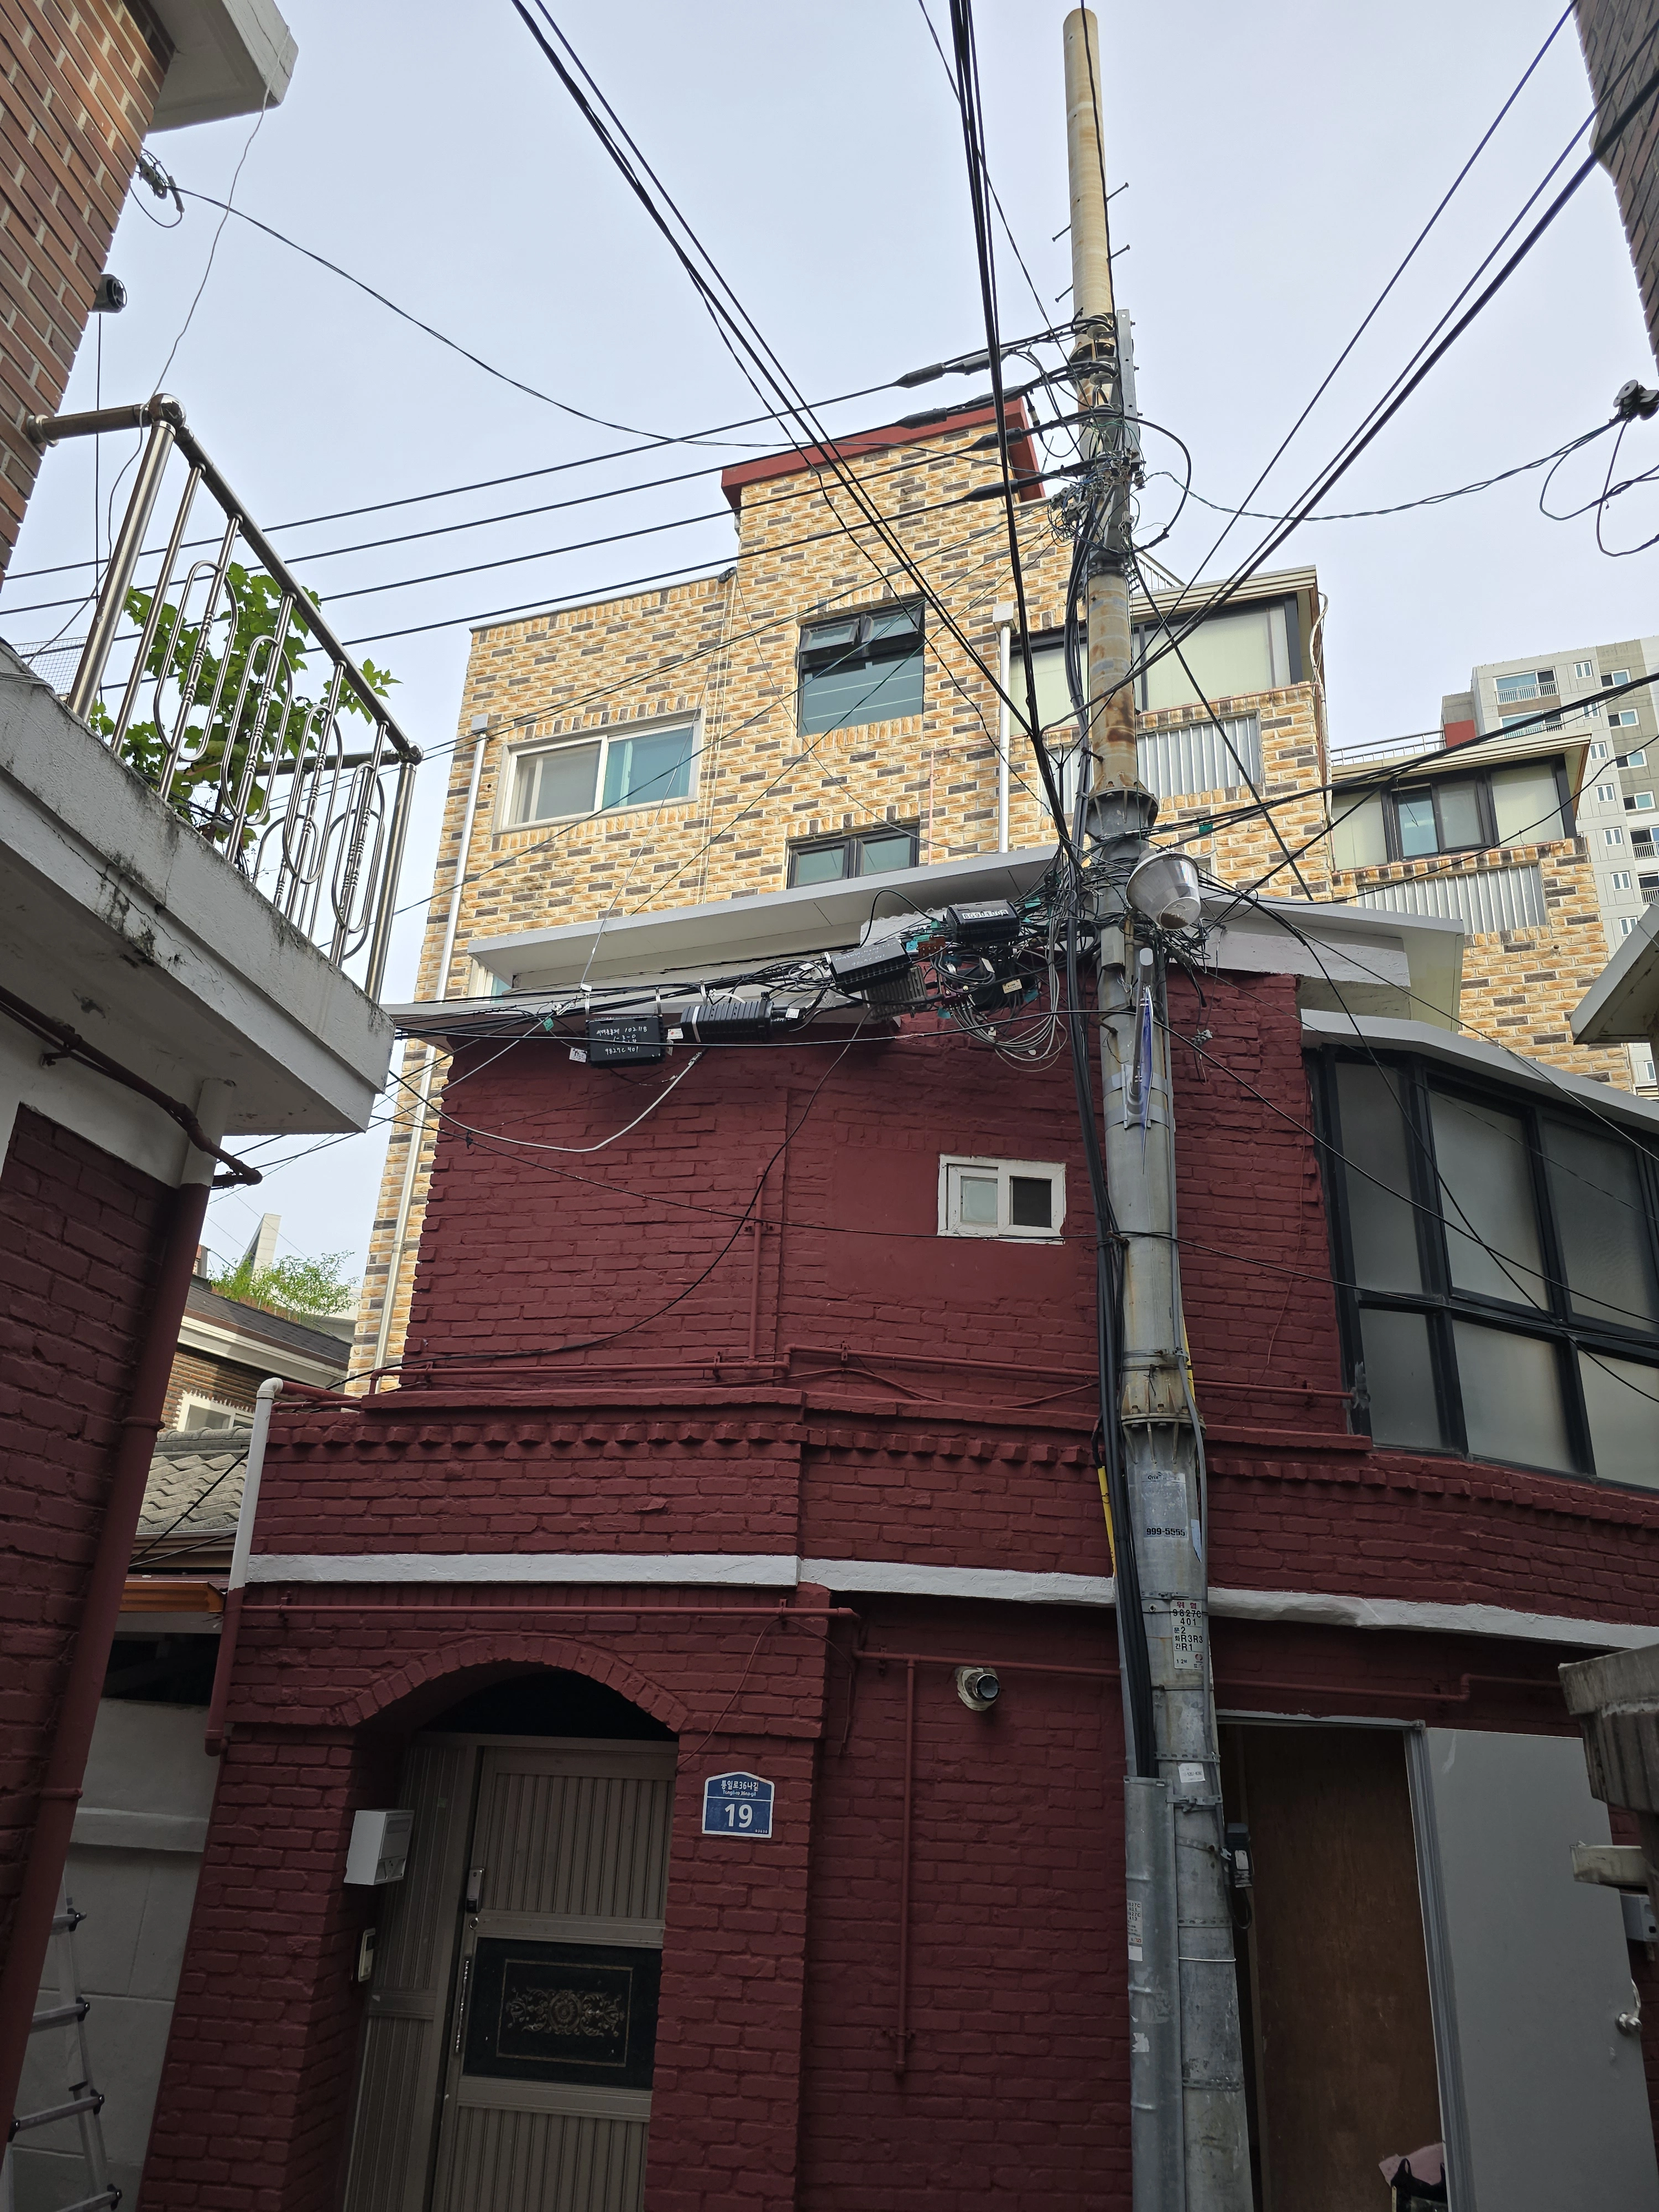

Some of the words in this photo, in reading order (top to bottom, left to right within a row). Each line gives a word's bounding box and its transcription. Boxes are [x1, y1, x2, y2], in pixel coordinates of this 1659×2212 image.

[1146, 1527, 1186, 1536] 999-5555
[1172, 1609, 1202, 1618] 9827C
[1180, 1618, 1197, 1626] 401
[721, 1780, 759, 1791] 통일로36나길
[724, 1803, 753, 1828] 19
